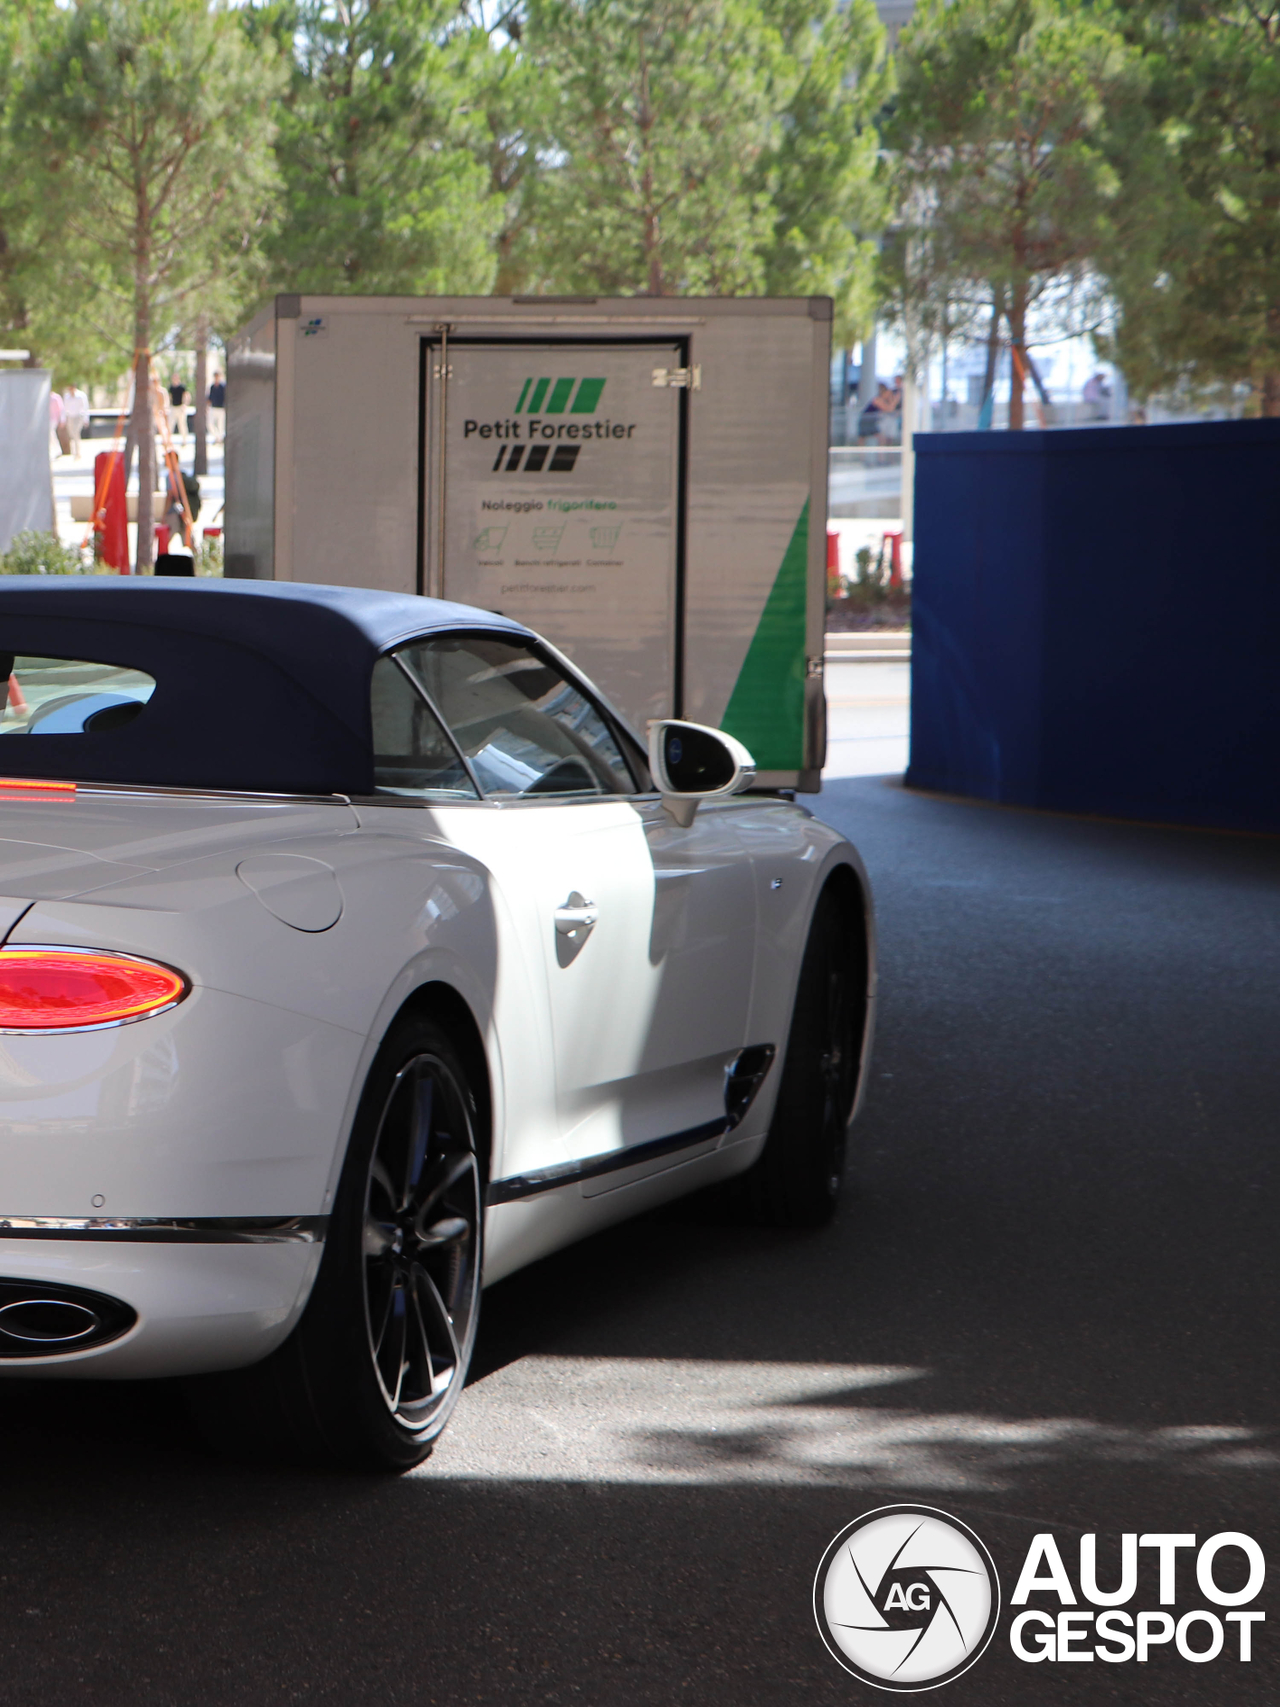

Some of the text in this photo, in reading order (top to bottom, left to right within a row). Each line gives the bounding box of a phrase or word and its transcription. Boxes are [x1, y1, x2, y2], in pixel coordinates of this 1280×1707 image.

[463, 419, 637, 439] Petit Forestier
[481, 498, 617, 512] Noleggio frigorifero
